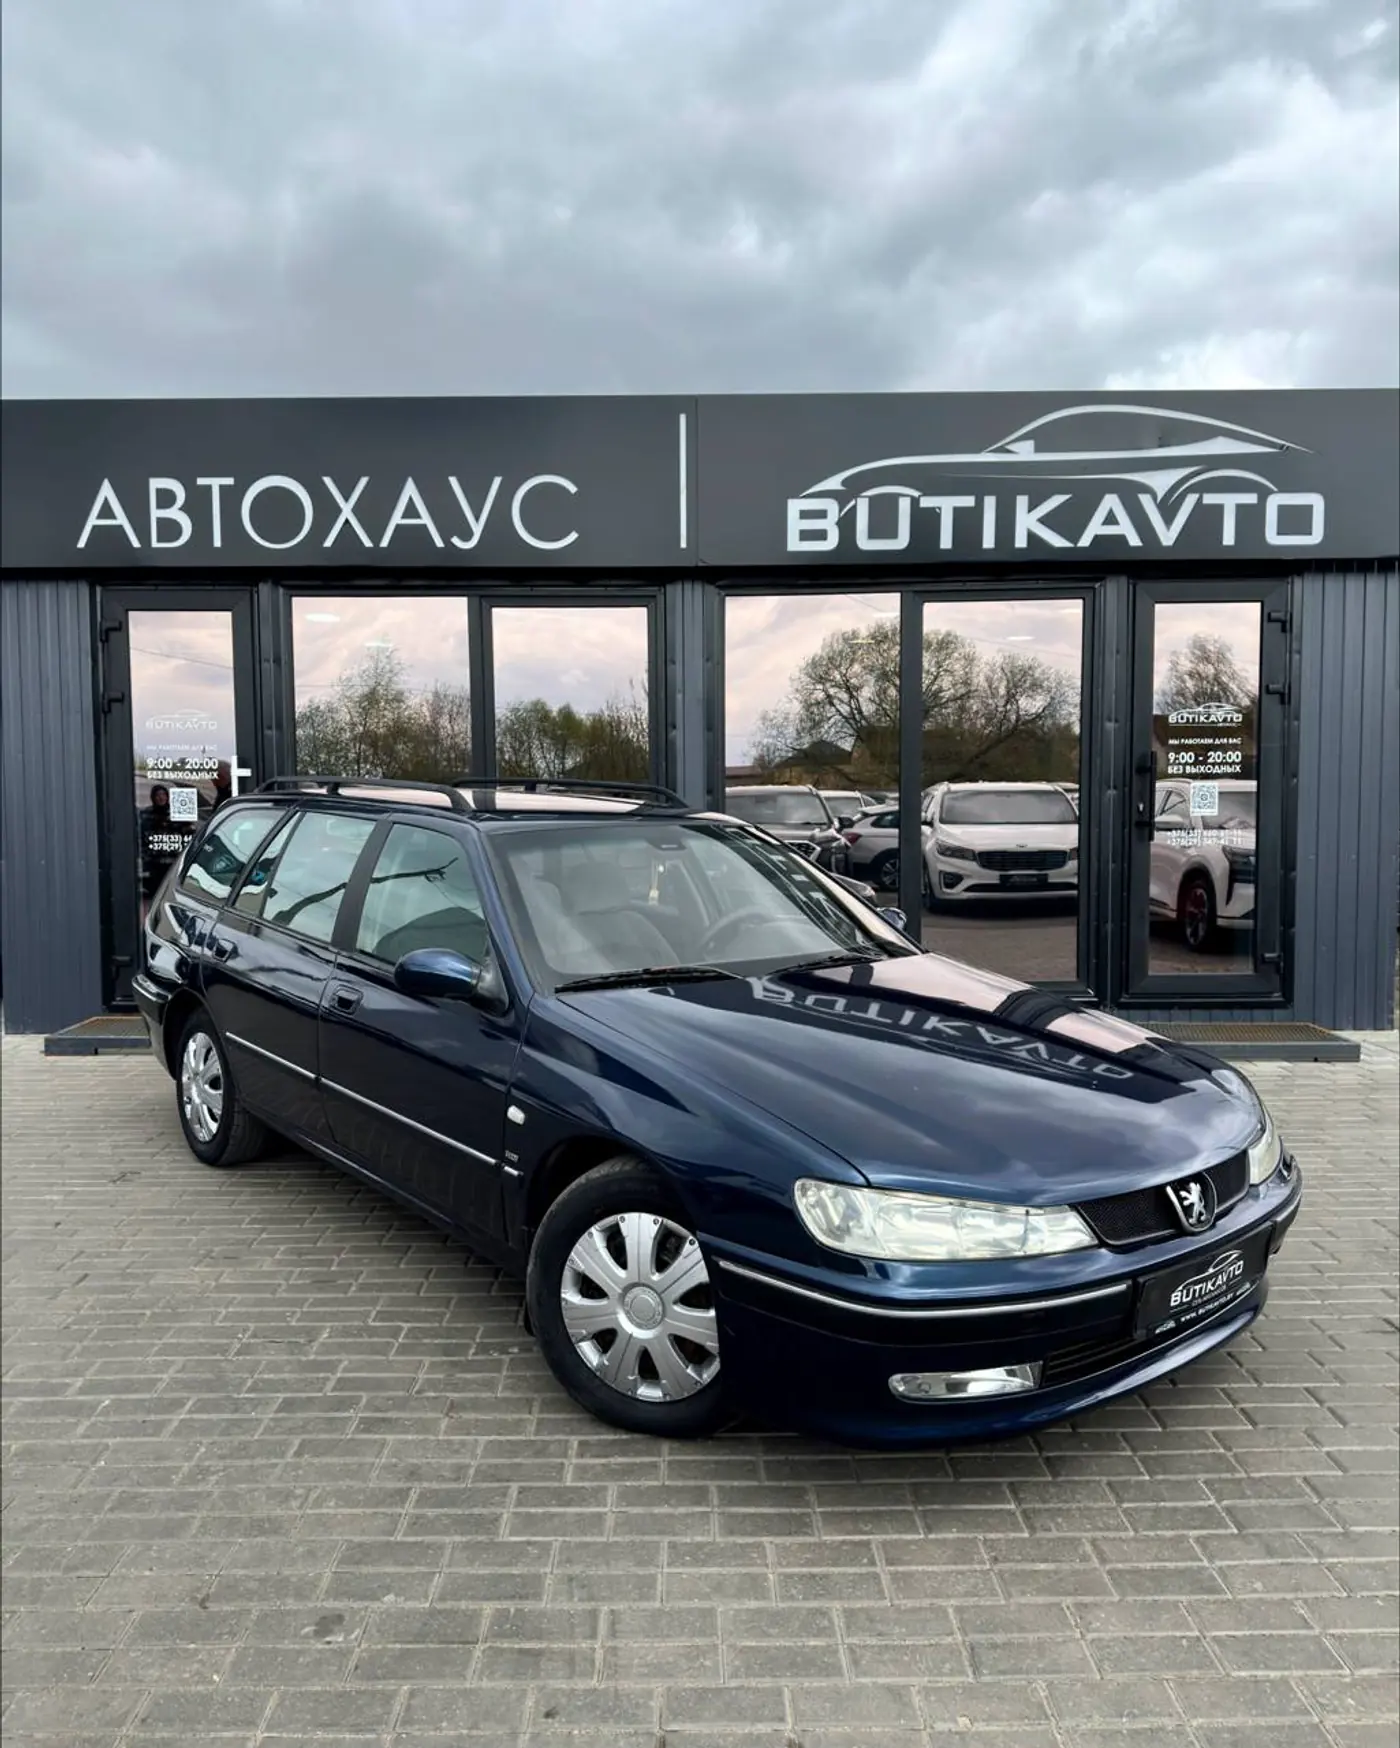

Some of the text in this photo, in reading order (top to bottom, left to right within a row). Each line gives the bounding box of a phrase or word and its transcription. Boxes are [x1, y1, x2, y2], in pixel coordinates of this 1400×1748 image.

[76, 474, 580, 550] АВТОХАУС
[786, 491, 1325, 552] BUTIKAVTO
[1167, 712, 1243, 724] BUTIKAVTO
[146, 757, 173, 769] 9:00
[185, 757, 219, 769] 20:00
[1167, 752, 1195, 763] 9:00
[1207, 751, 1242, 763] 20:00
[164, 770, 219, 780] ВЫХОДНЫХ
[1167, 764, 1242, 774] БЕЗ ВЫХОДНЫХ
[148, 834, 182, 844] +375(33)
[1170, 1260, 1244, 1306] BUTIKAVTO
